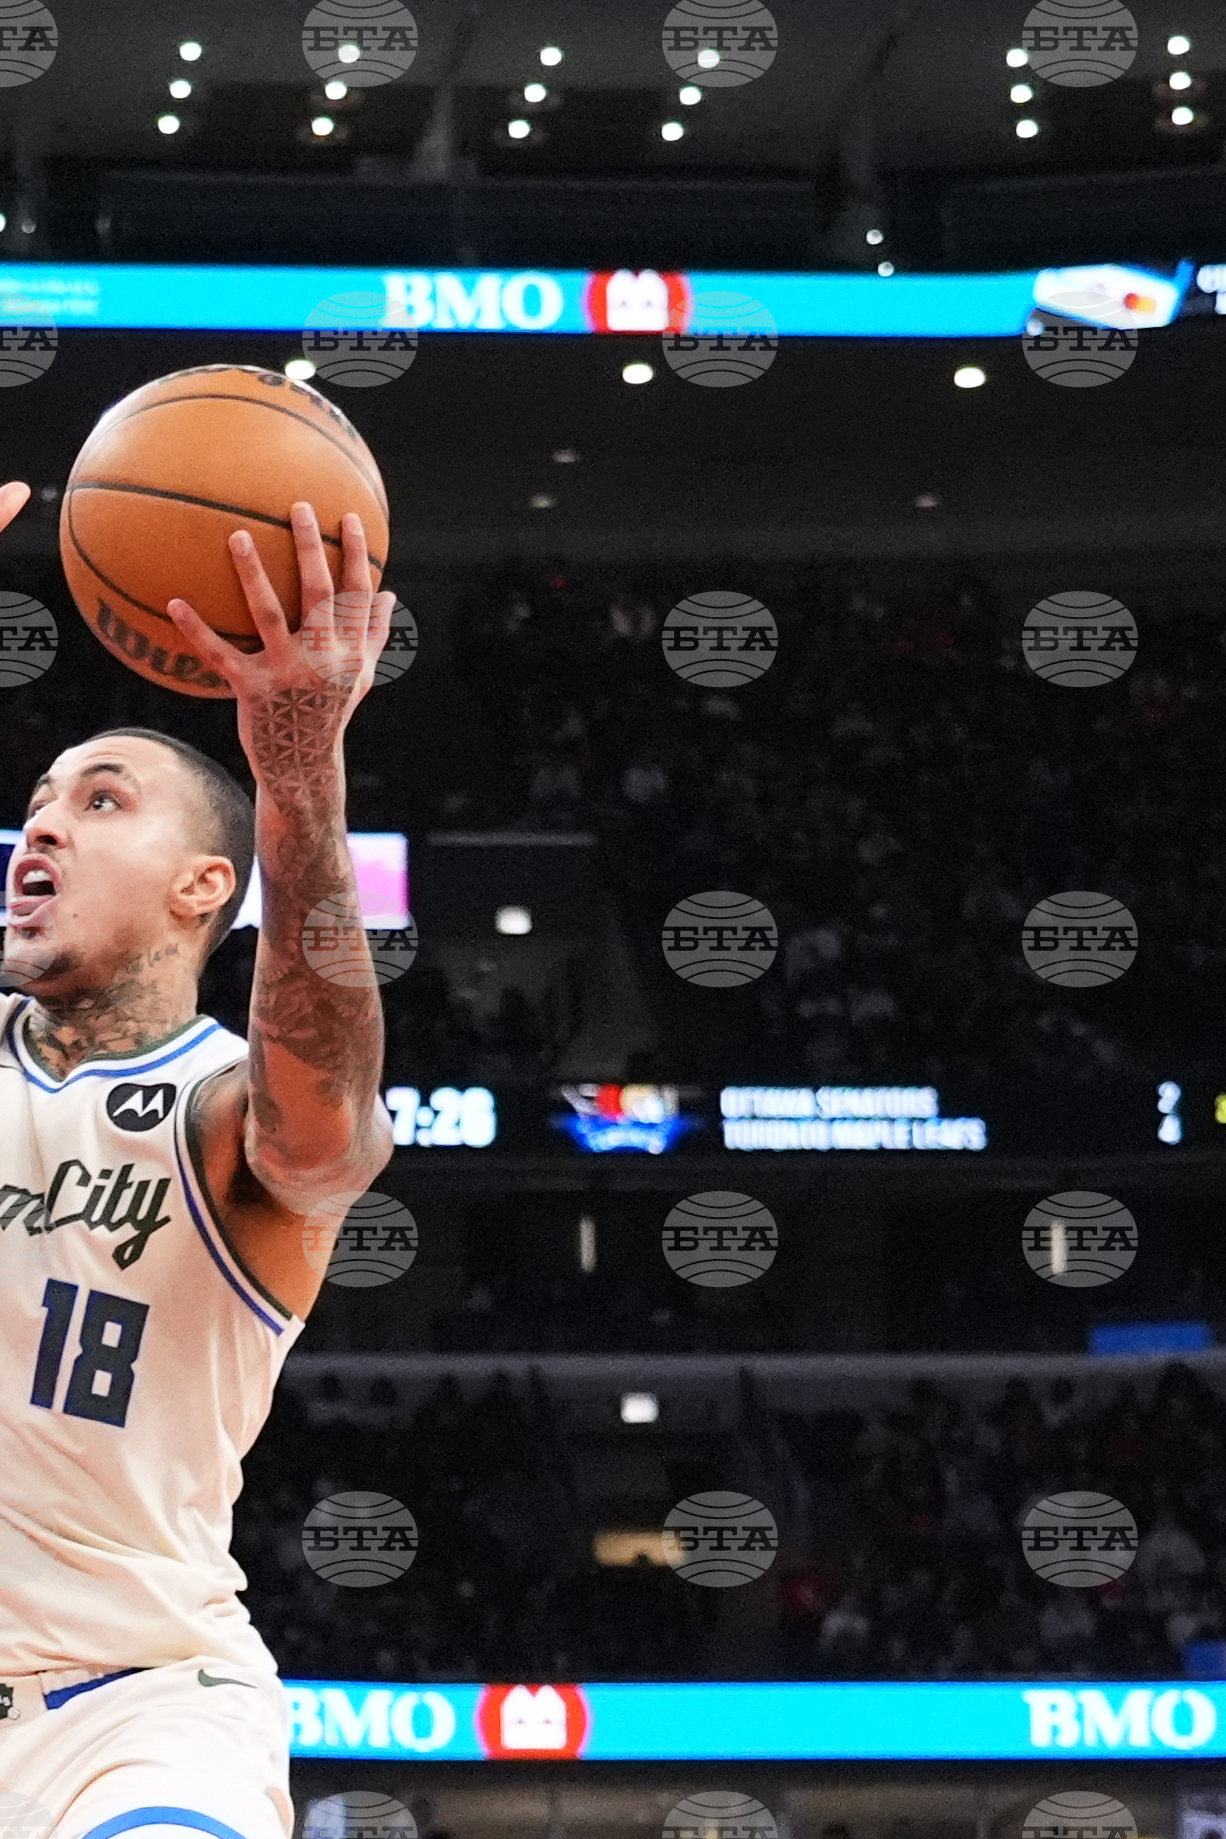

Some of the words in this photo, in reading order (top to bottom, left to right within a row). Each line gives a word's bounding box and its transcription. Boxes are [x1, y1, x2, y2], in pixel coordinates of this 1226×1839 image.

[379, 271, 562, 330] BMO
[30, 1277, 151, 1429] 18
[286, 1687, 456, 1753] BMO
[1022, 1688, 1217, 1750] BMO
